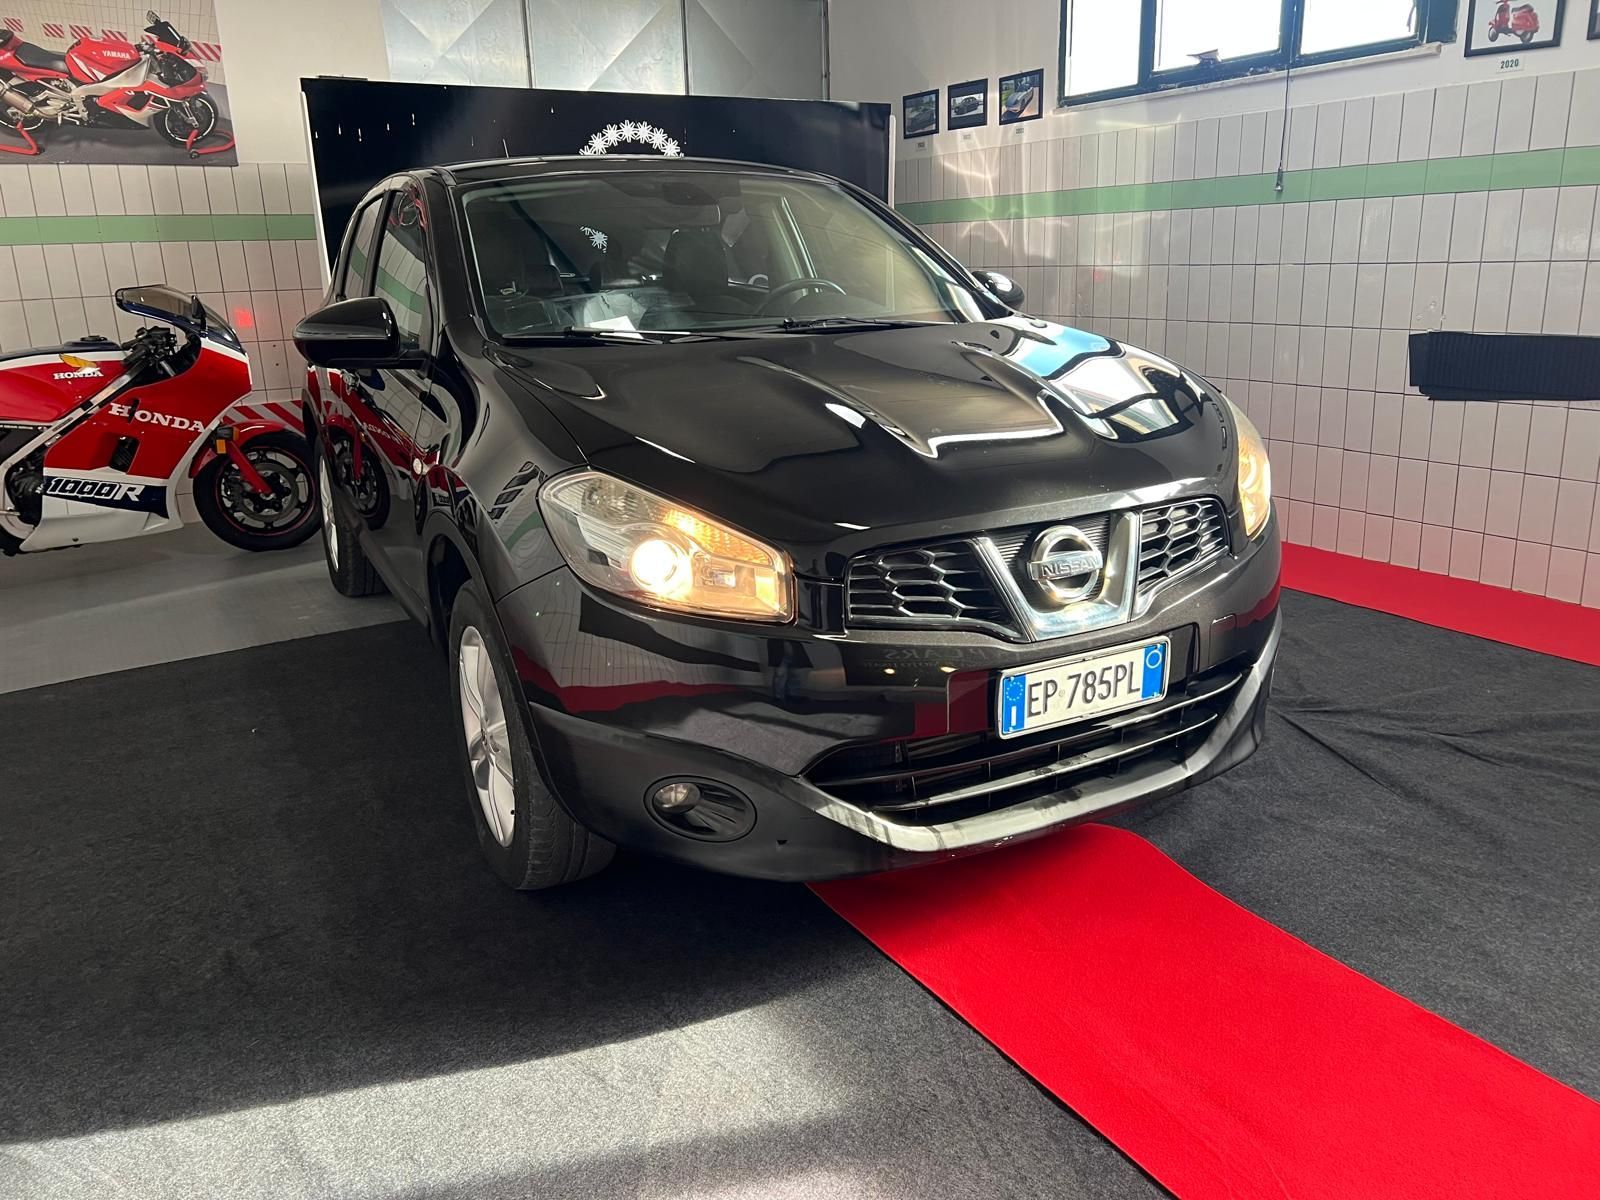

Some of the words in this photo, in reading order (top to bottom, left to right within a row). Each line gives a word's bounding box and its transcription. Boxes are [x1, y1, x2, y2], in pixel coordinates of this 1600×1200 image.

[102, 50, 131, 60] YAMAHA
[1500, 58, 1519, 69] 2020
[53, 367, 104, 380] HONDA
[108, 402, 206, 433] HONDA
[46, 477, 146, 501] 1000R
[1041, 556, 1099, 578] NISSAN
[1027, 679, 1058, 717] EP
[1066, 661, 1141, 709] 785PL
